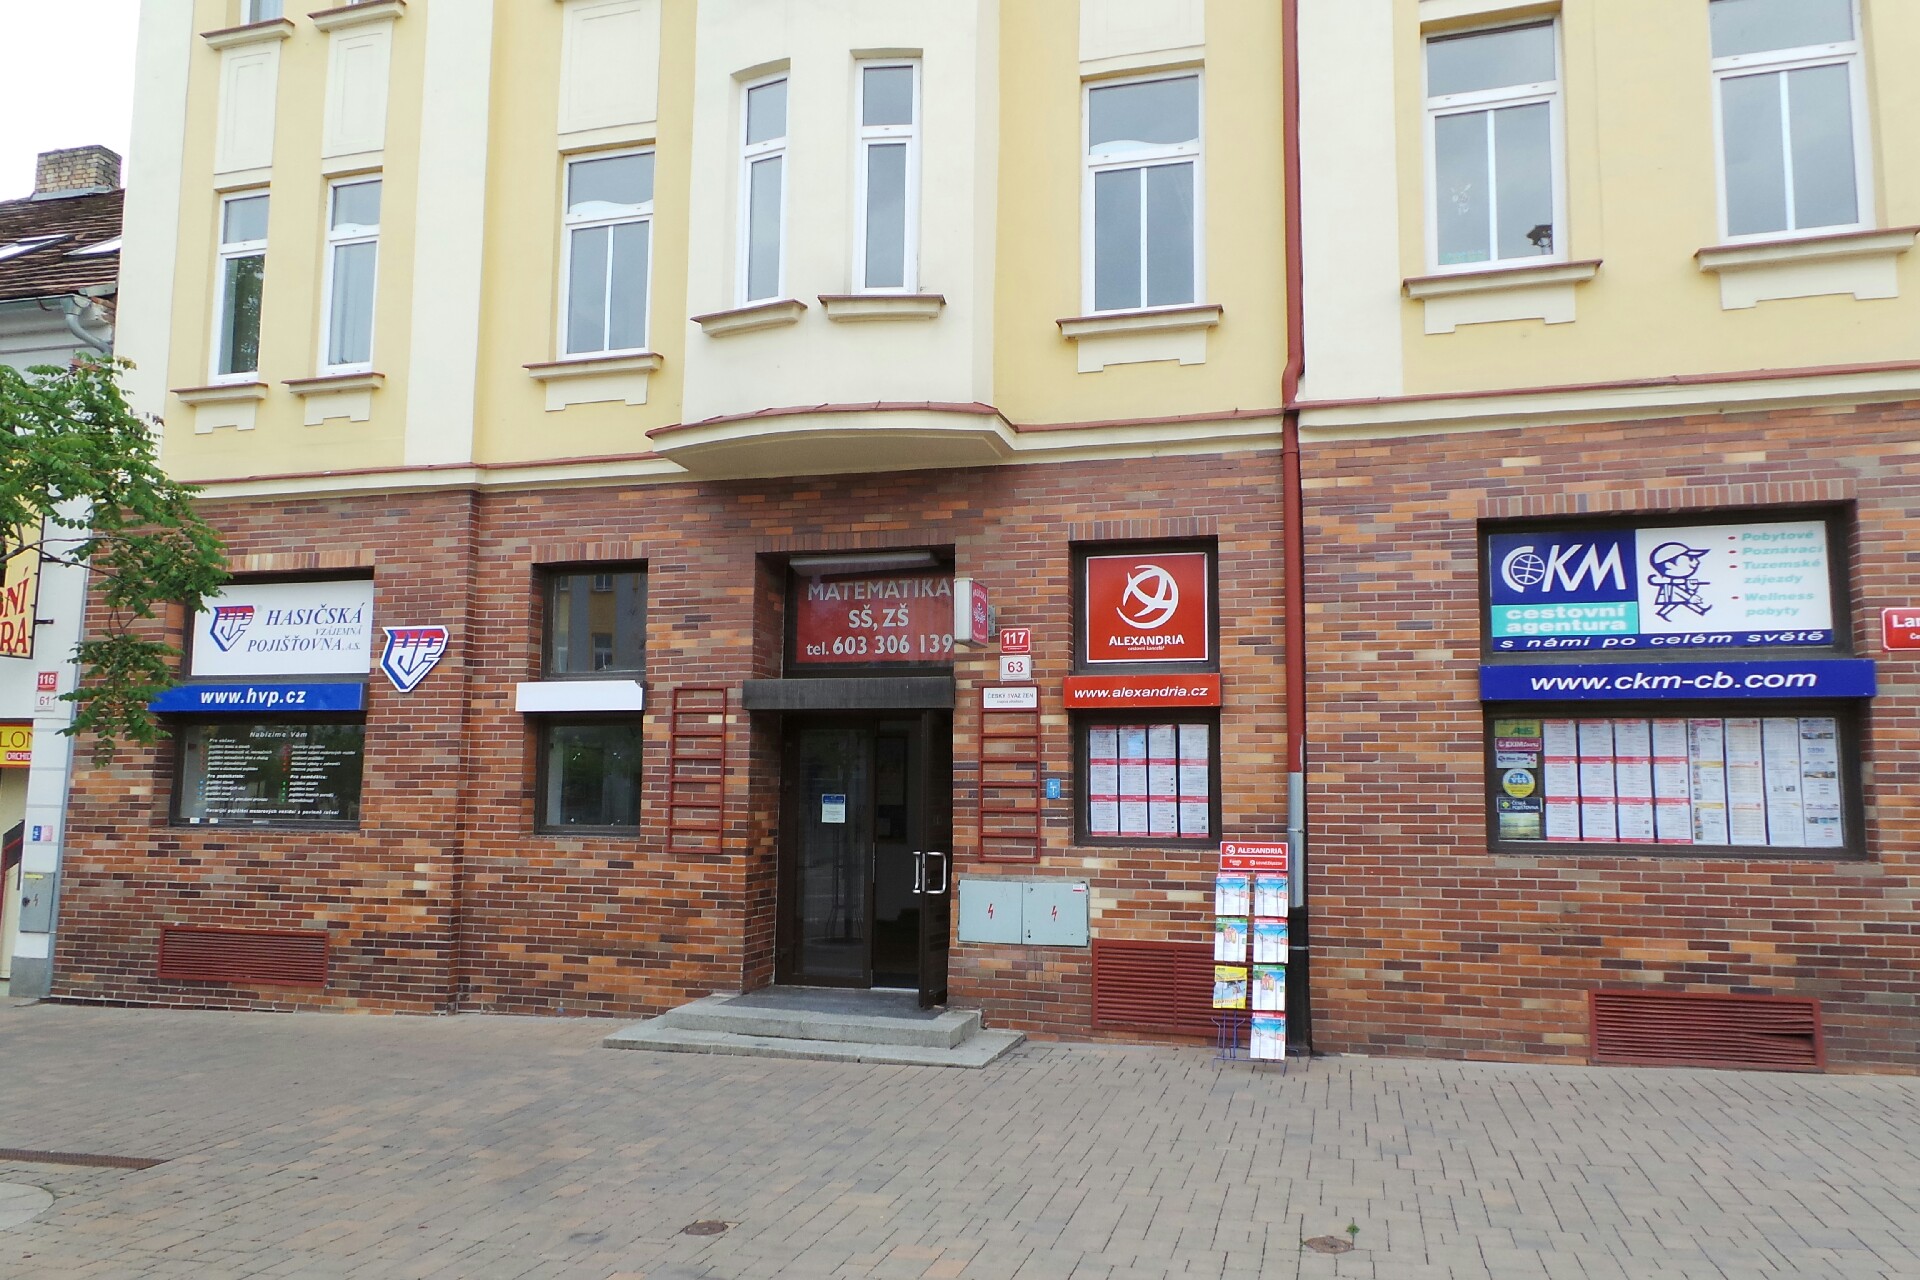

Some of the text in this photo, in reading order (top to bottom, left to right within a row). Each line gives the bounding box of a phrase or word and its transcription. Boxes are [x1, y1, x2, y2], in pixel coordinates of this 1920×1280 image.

[1741, 531, 1814, 543] Pobytové
[1742, 544, 1824, 556] Poznávací
[1501, 542, 1627, 593] CKM
[1743, 559, 1821, 570] Tuzemské
[1743, 574, 1803, 585] zájezdy
[808, 577, 951, 601] MATEMATIKA
[1744, 592, 1814, 602] Wellness
[265, 602, 366, 626] HASIČSKÁ
[848, 604, 909, 631] SŠ, ZŠ
[1505, 605, 1626, 619] cestovní
[1745, 607, 1799, 618] pobyty
[315, 626, 363, 636] VZÁJEMNÁ
[1505, 619, 1627, 634] agentura
[1003, 631, 1026, 645] 117
[1108, 634, 1185, 646] ALEXANDRIA
[1500, 629, 1824, 648] s námi po celém světě
[806, 641, 829, 656] tel.
[832, 636, 868, 656] 603
[874, 635, 910, 655] 306
[920, 634, 953, 653] 139
[1007, 661, 1023, 673] 63
[39, 674, 55, 684] 116
[1530, 671, 1817, 690] www.ckm-cb.com
[200, 687, 306, 707] www.hvp.cz
[1074, 686, 1208, 698] www.alexandria.cz
[39, 696, 50, 705] 61
[1237, 846, 1283, 855] ALEXANDRIA
